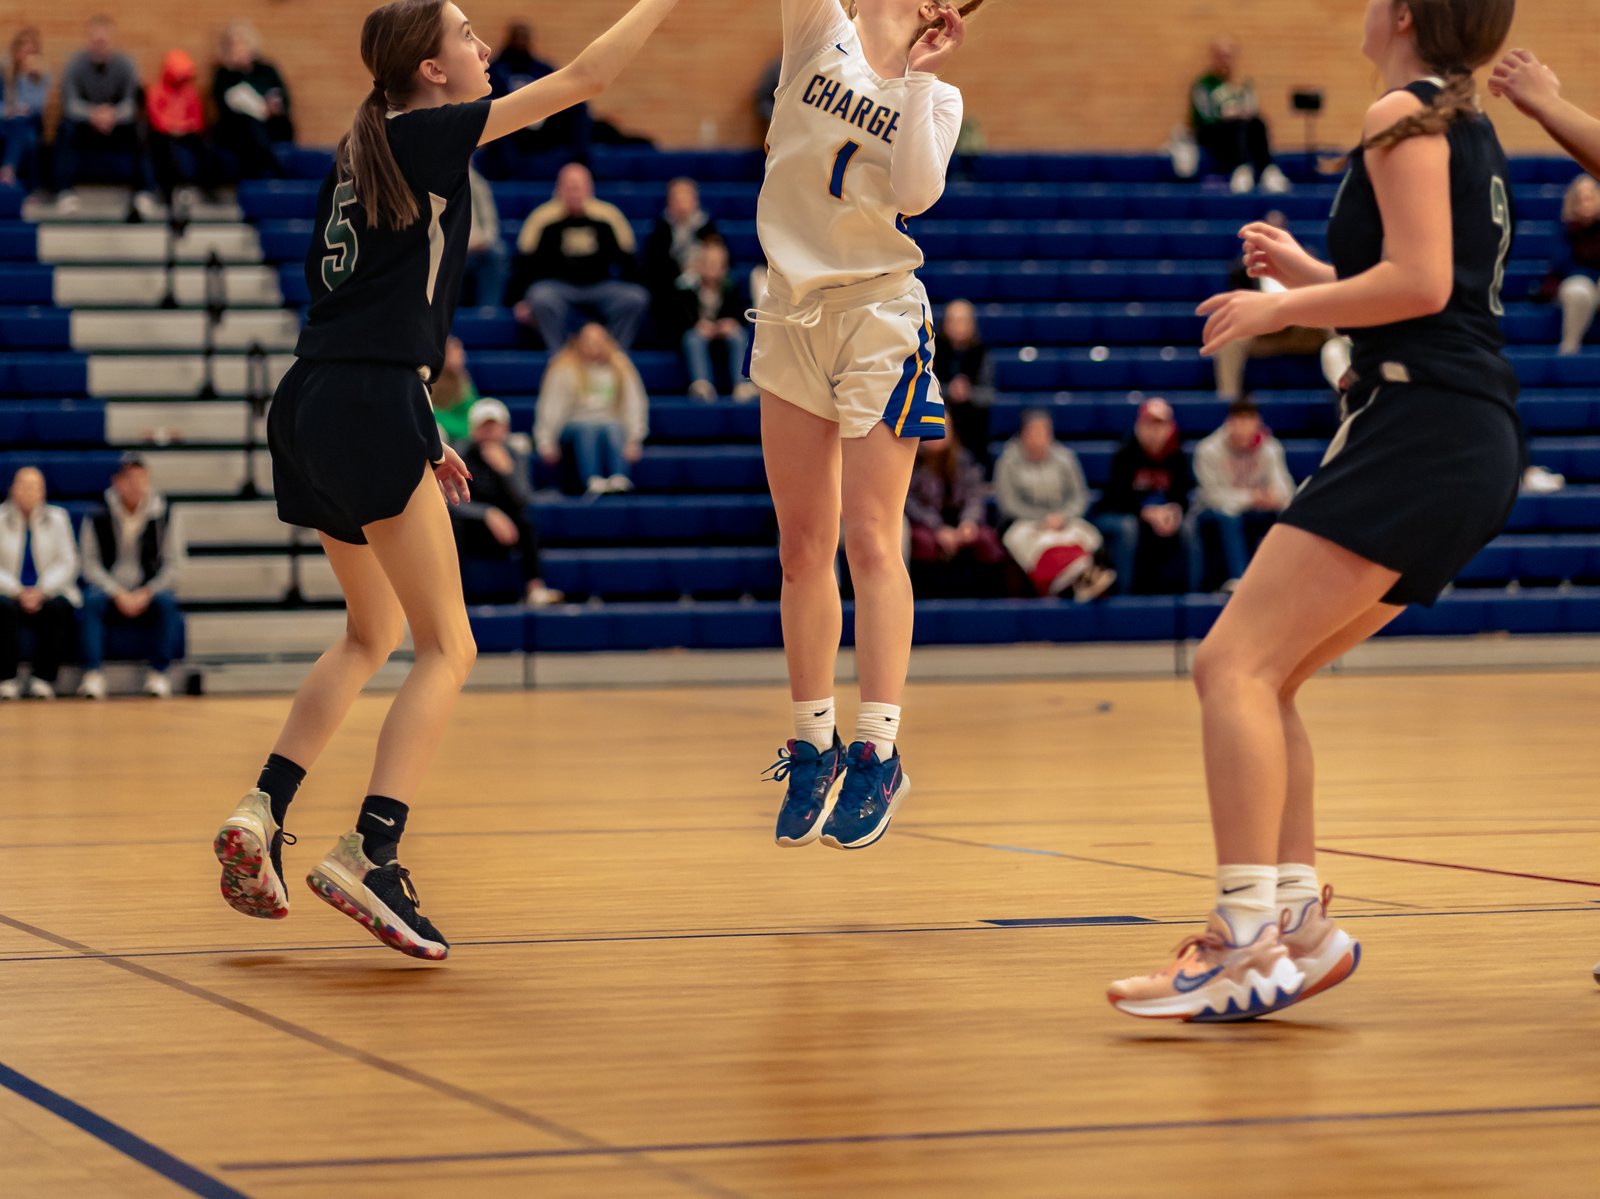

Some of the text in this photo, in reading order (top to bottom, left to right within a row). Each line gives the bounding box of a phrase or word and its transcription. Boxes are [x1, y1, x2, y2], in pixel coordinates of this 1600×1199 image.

[802, 74, 901, 144] CHARGE
[827, 137, 863, 202] 1
[321, 178, 359, 292] 5
